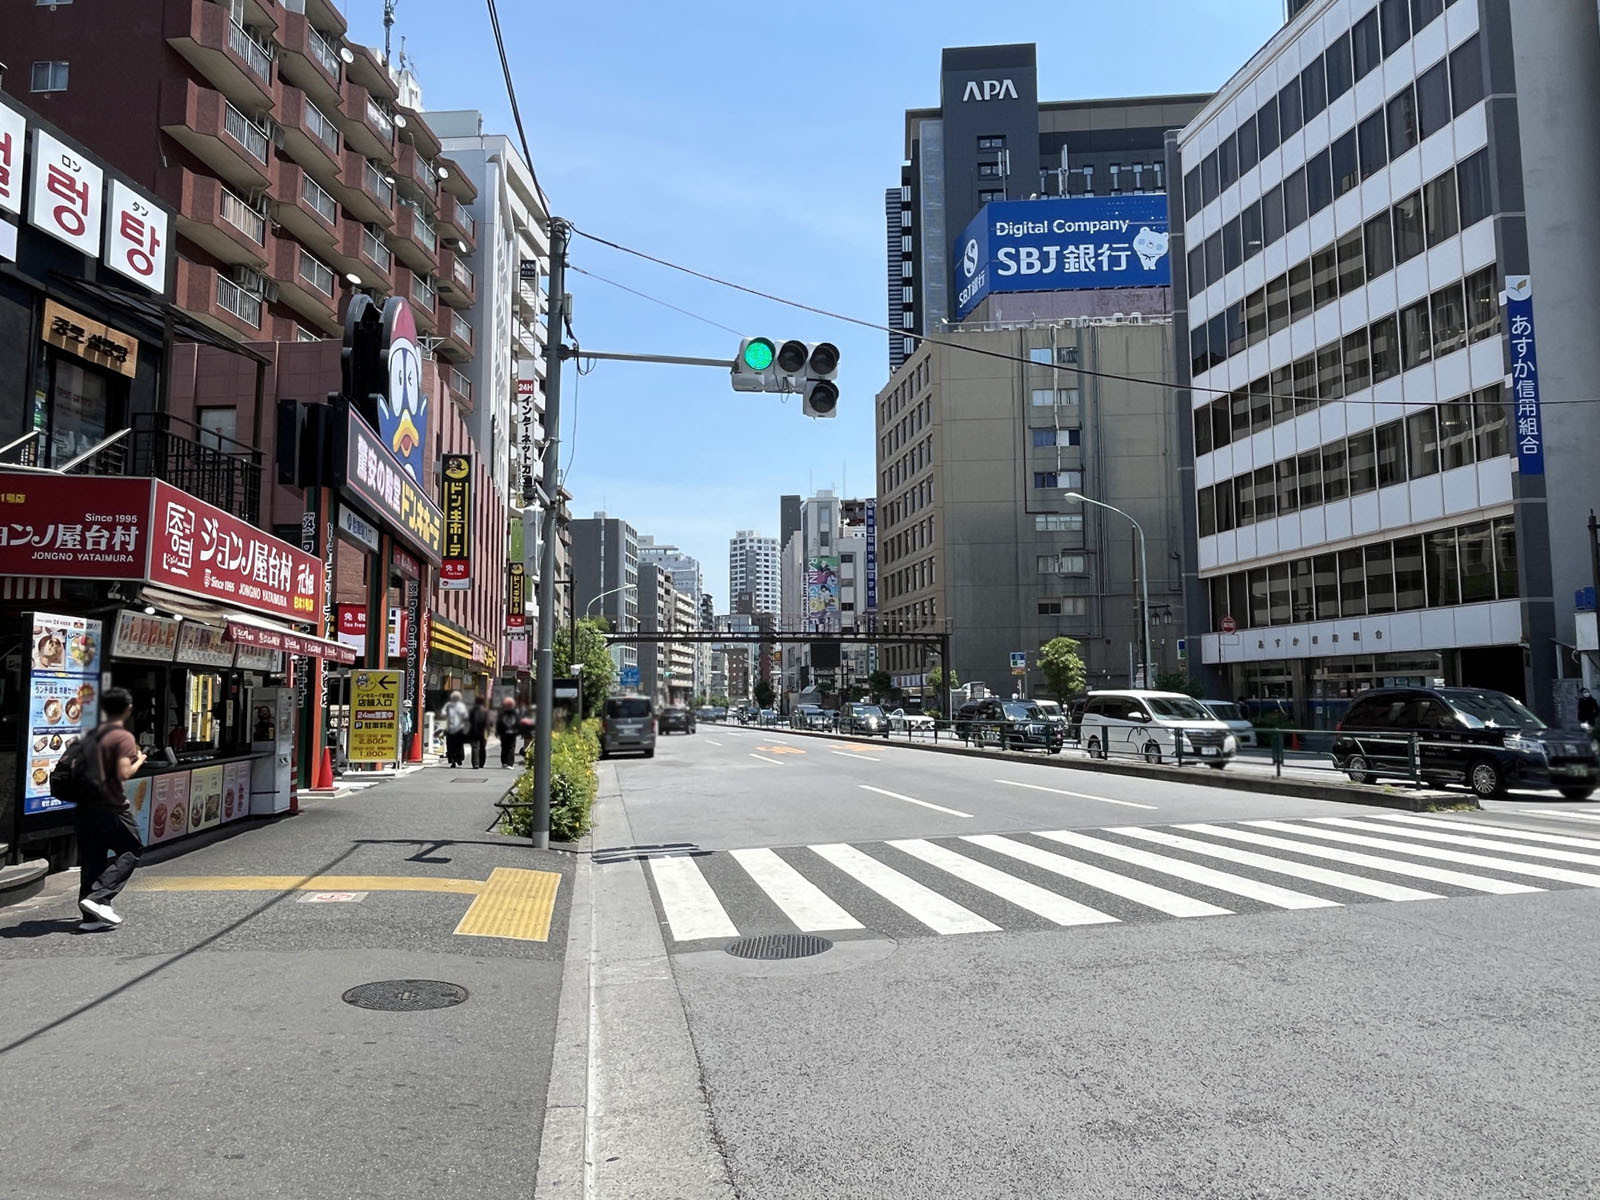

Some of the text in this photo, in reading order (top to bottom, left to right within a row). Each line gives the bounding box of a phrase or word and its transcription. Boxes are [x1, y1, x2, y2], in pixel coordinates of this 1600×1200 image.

[963, 79, 1018, 102] APA
[61, 154, 82, 173] ロン
[132, 201, 149, 217] タン
[996, 219, 1130, 238] Digital Company
[997, 243, 1132, 276] SBJ銀行
[518, 383, 533, 391] 24H
[1511, 315, 1539, 454] あすか信用組合
[85, 513, 138, 524] Since 1995
[31, 551, 135, 563] JONGNO YATAIMURA
[200, 516, 293, 593] ジョンノ屋台村
[297, 562, 315, 595] 元祖
